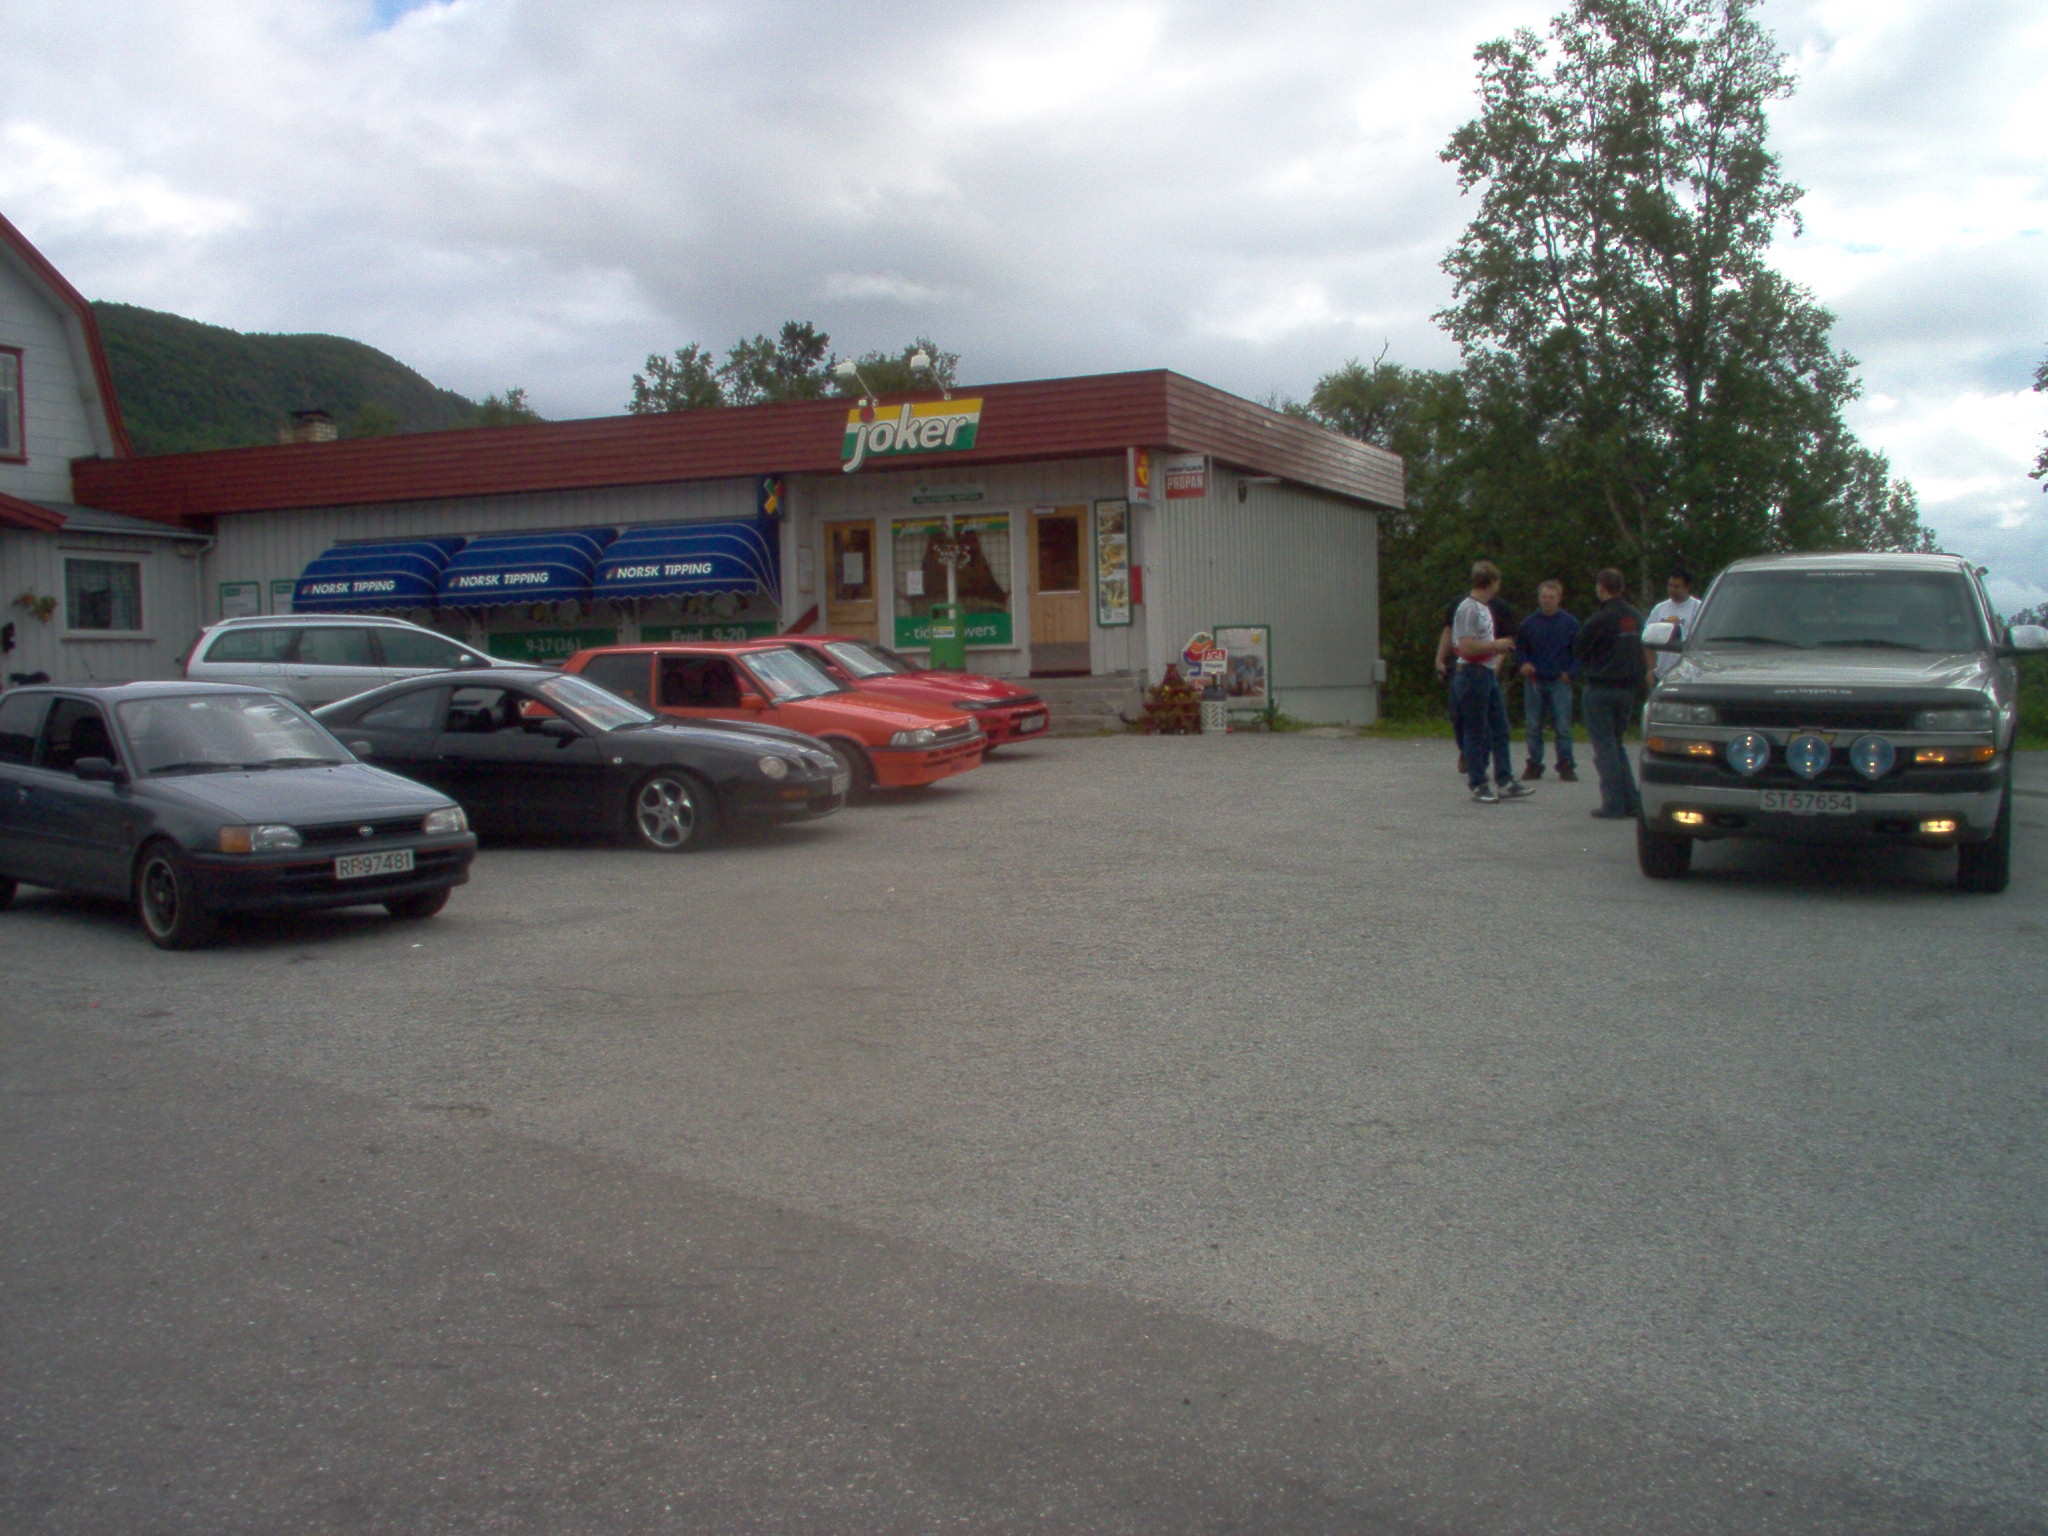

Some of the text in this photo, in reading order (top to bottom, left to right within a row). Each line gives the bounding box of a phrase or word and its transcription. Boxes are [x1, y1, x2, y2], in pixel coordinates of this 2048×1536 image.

[843, 403, 968, 472] joker
[617, 562, 712, 579] NORSK TIPPING
[311, 580, 395, 595] NORSK TIPPING
[459, 572, 549, 587] NORSK TIPPING
